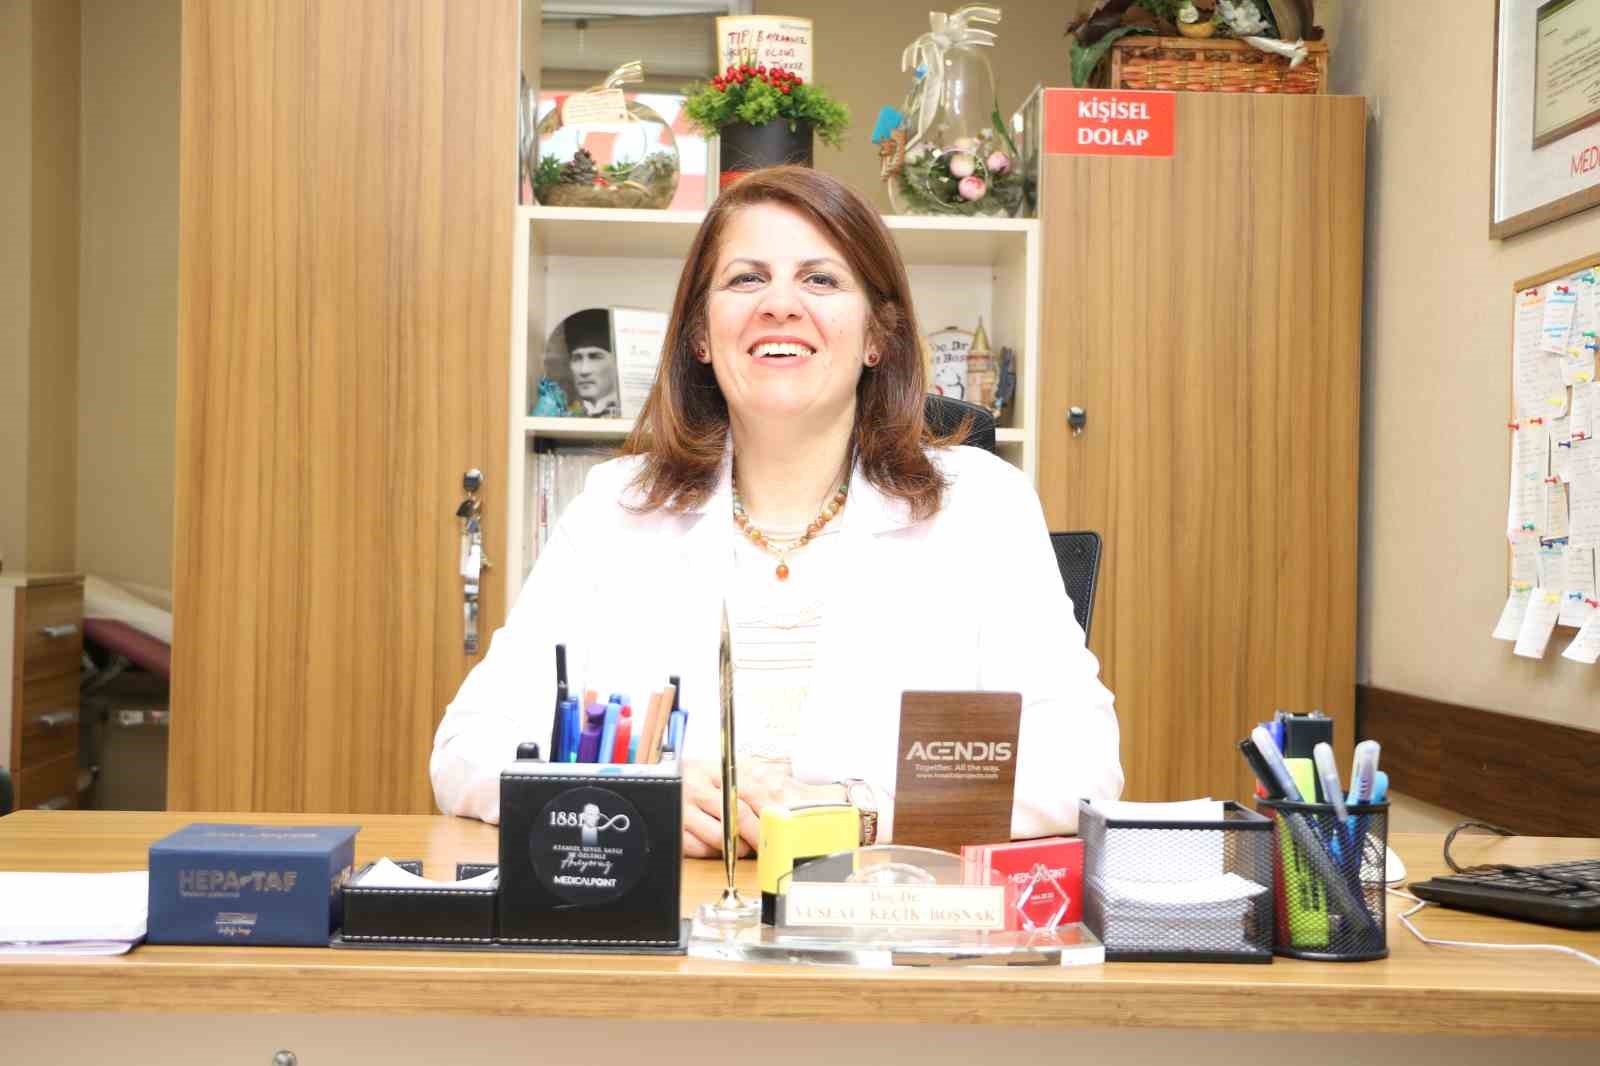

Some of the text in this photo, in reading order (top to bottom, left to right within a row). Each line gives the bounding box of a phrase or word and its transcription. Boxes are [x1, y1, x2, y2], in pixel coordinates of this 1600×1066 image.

[1077, 97, 1150, 123] KİŞİSEL
[1077, 127, 1149, 146] DOLAP
[905, 741, 1013, 761] ACENDIS
